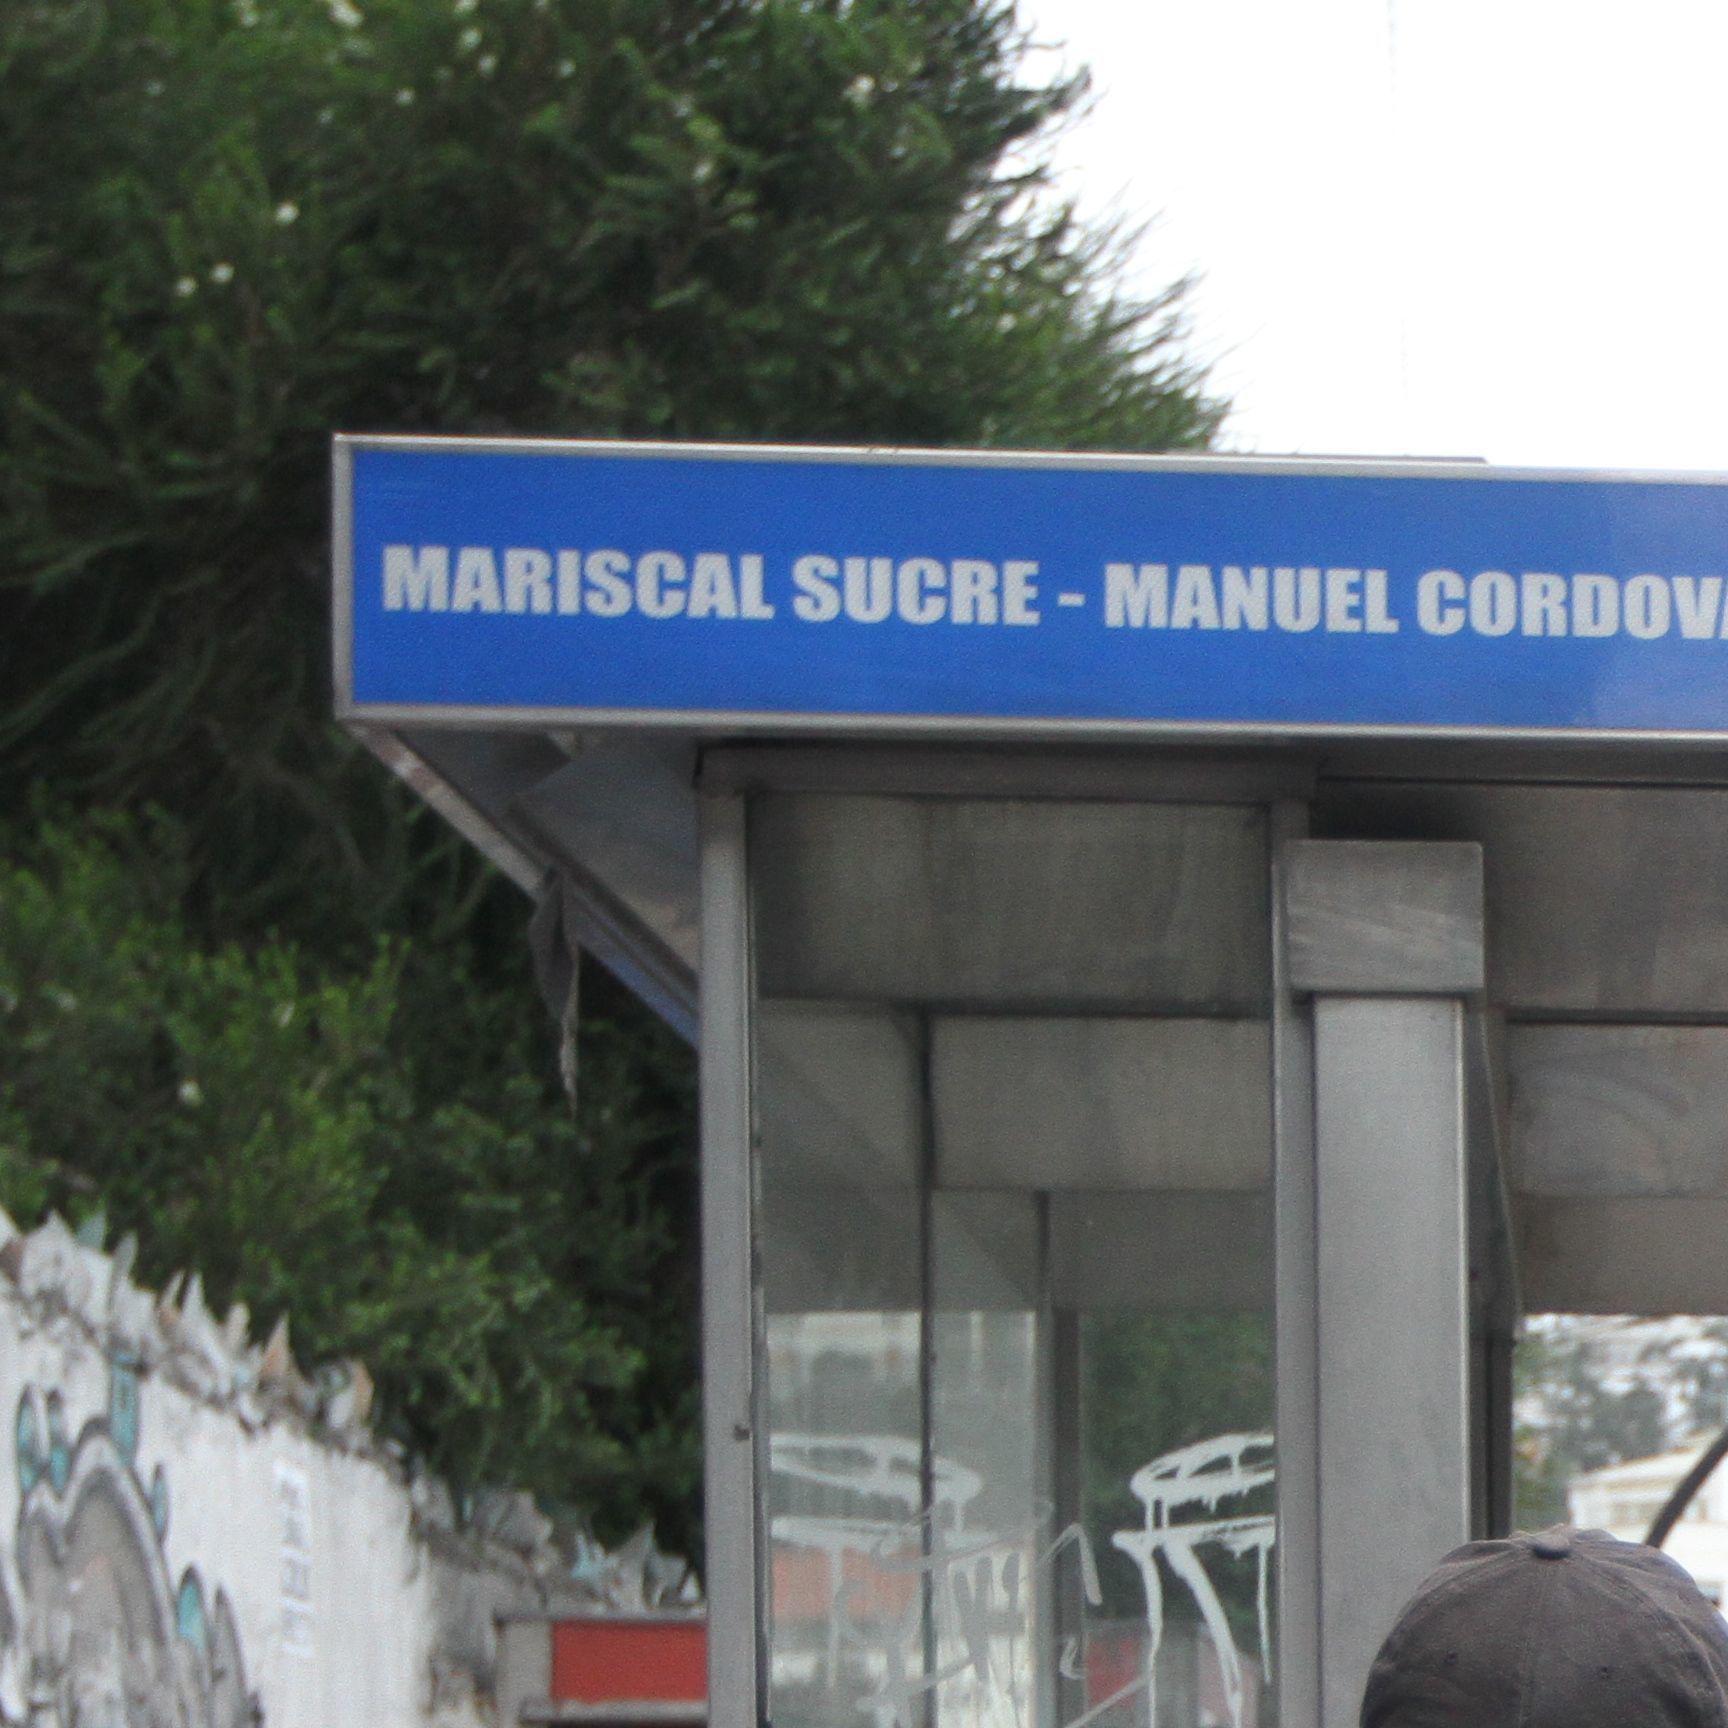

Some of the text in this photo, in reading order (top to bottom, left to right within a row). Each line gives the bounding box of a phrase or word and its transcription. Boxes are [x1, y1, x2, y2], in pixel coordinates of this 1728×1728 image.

[384, 545, 775, 619] MARISCAL
[793, 555, 1040, 625] SUCRE
[1104, 564, 1399, 633] MANUEL
